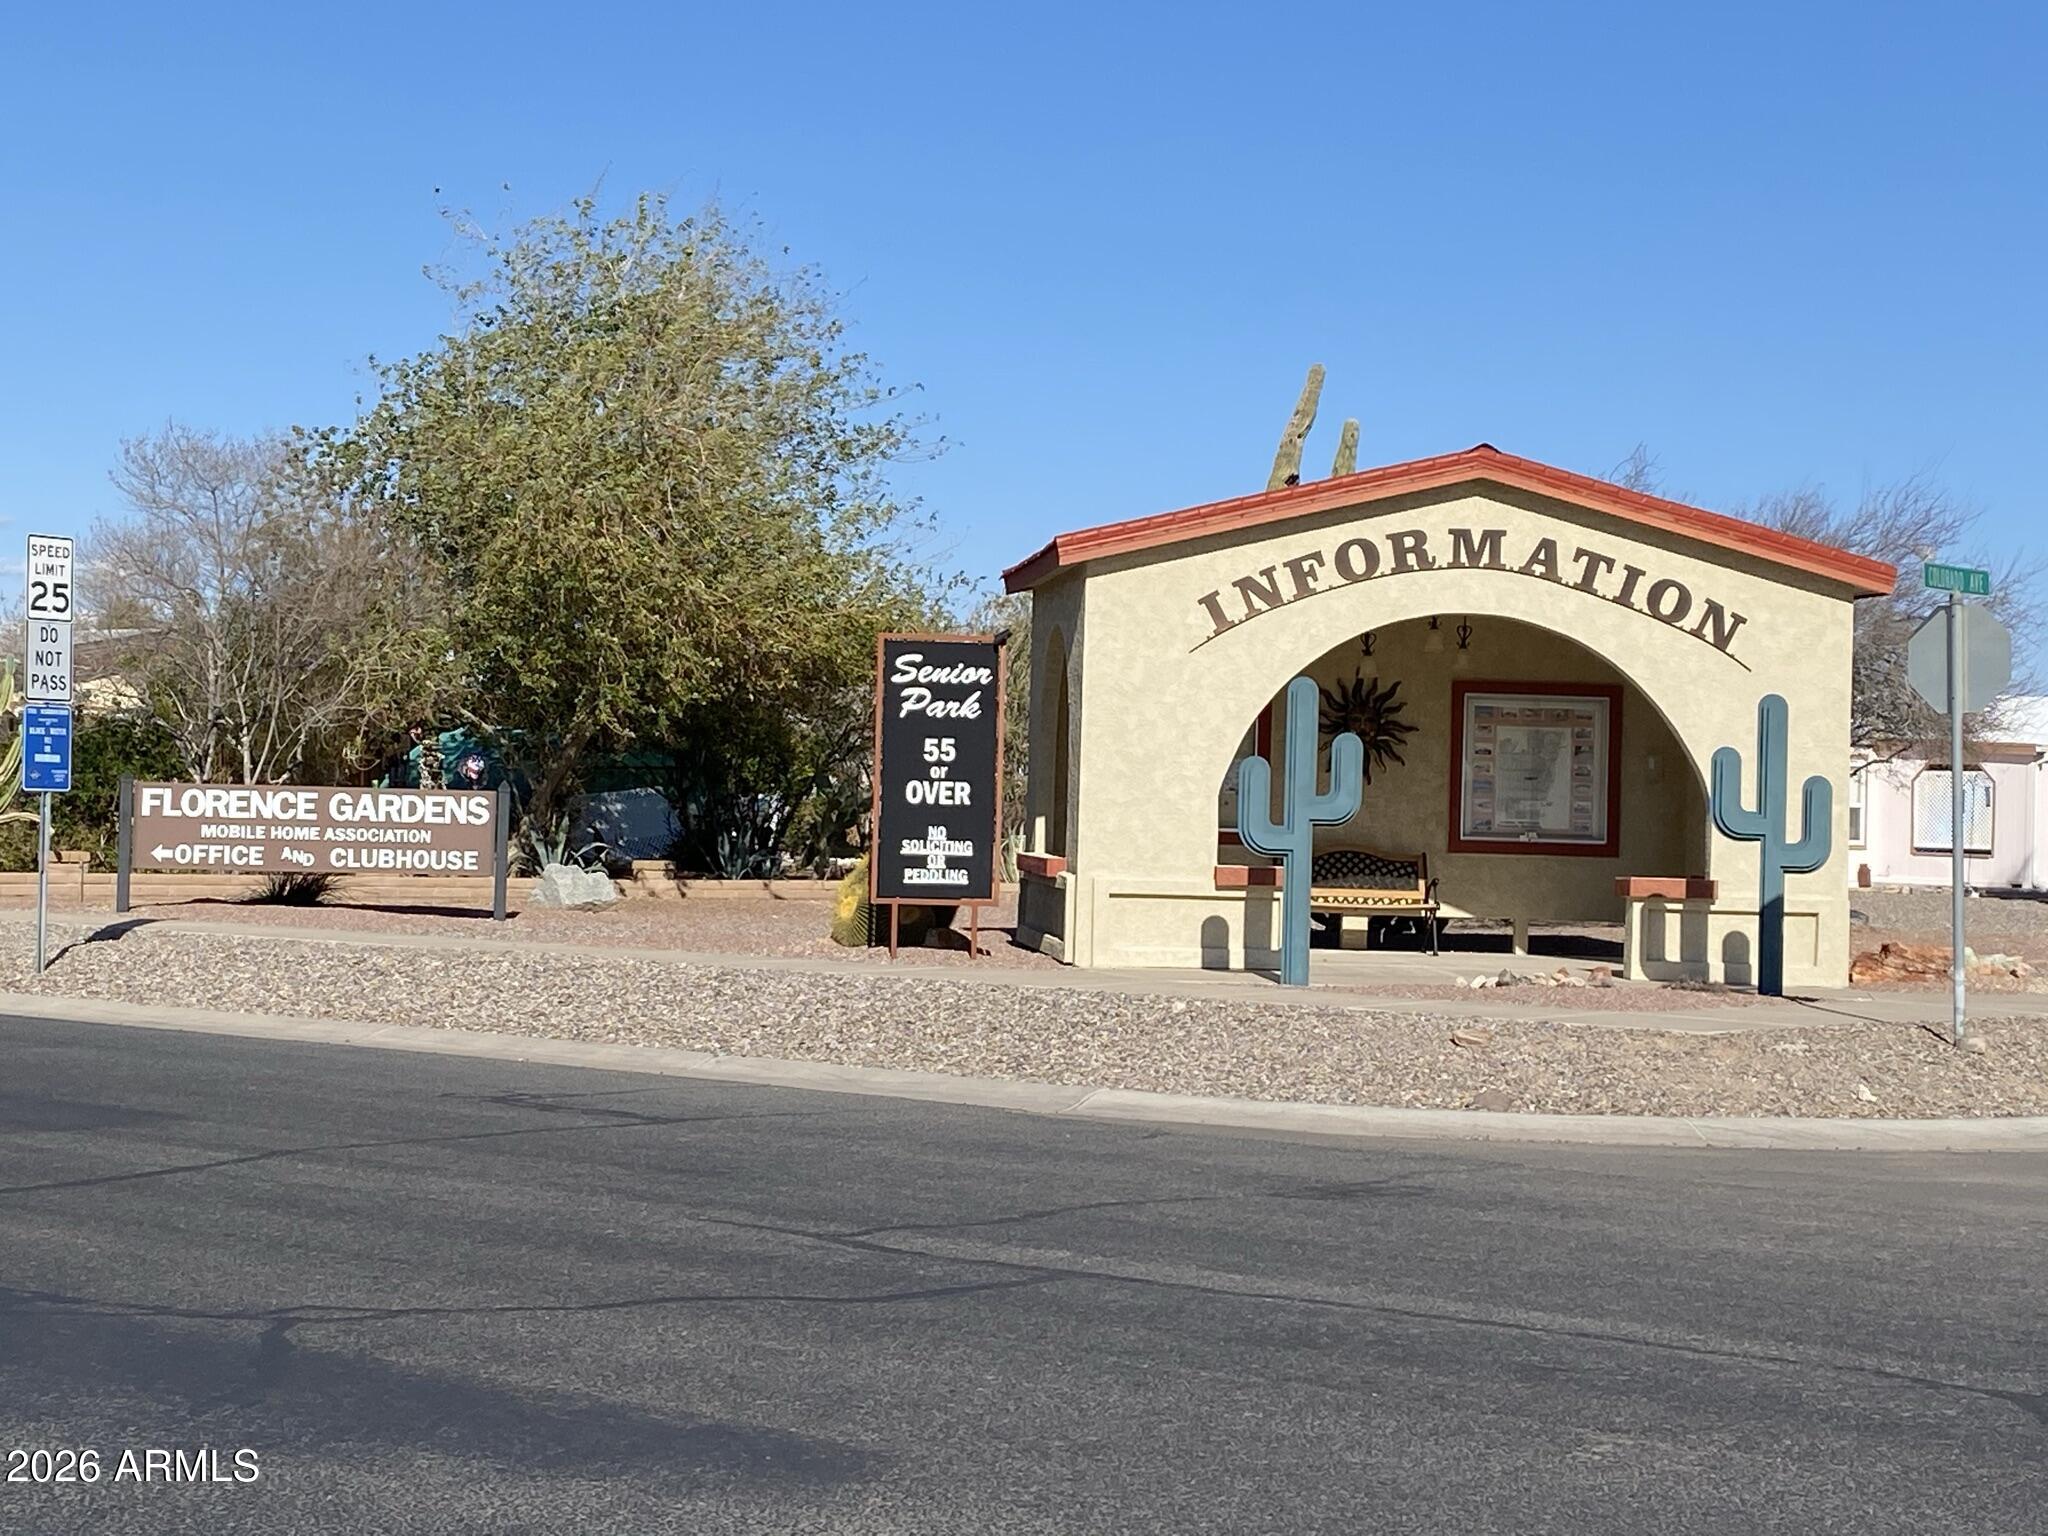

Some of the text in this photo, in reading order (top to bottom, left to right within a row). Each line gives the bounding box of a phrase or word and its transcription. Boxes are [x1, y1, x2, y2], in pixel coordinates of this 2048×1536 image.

[31, 543, 70, 558] SPEED
[34, 562, 66, 577] LIMIT
[1197, 528, 1748, 651] INFORMATION
[1970, 574, 1984, 592] AVE
[30, 581, 70, 613] 25
[40, 626, 58, 644] DO
[35, 651, 62, 667] NOT
[891, 653, 993, 686] Senior
[31, 675, 67, 692] PASS
[899, 687, 983, 719] Park
[923, 738, 956, 762] 55
[930, 765, 948, 779] or
[905, 781, 971, 806] OVER
[141, 787, 491, 826] FLORENCE GARDENS
[201, 825, 432, 844] MOBILE HOME ASSOCIATION
[928, 826, 947, 839] NO
[900, 839, 973, 855] SOLICITING
[174, 845, 479, 871] OFFICE AND CLUBHOUSE
[927, 855, 946, 868] OR
[903, 868, 969, 884] PEDDLING
